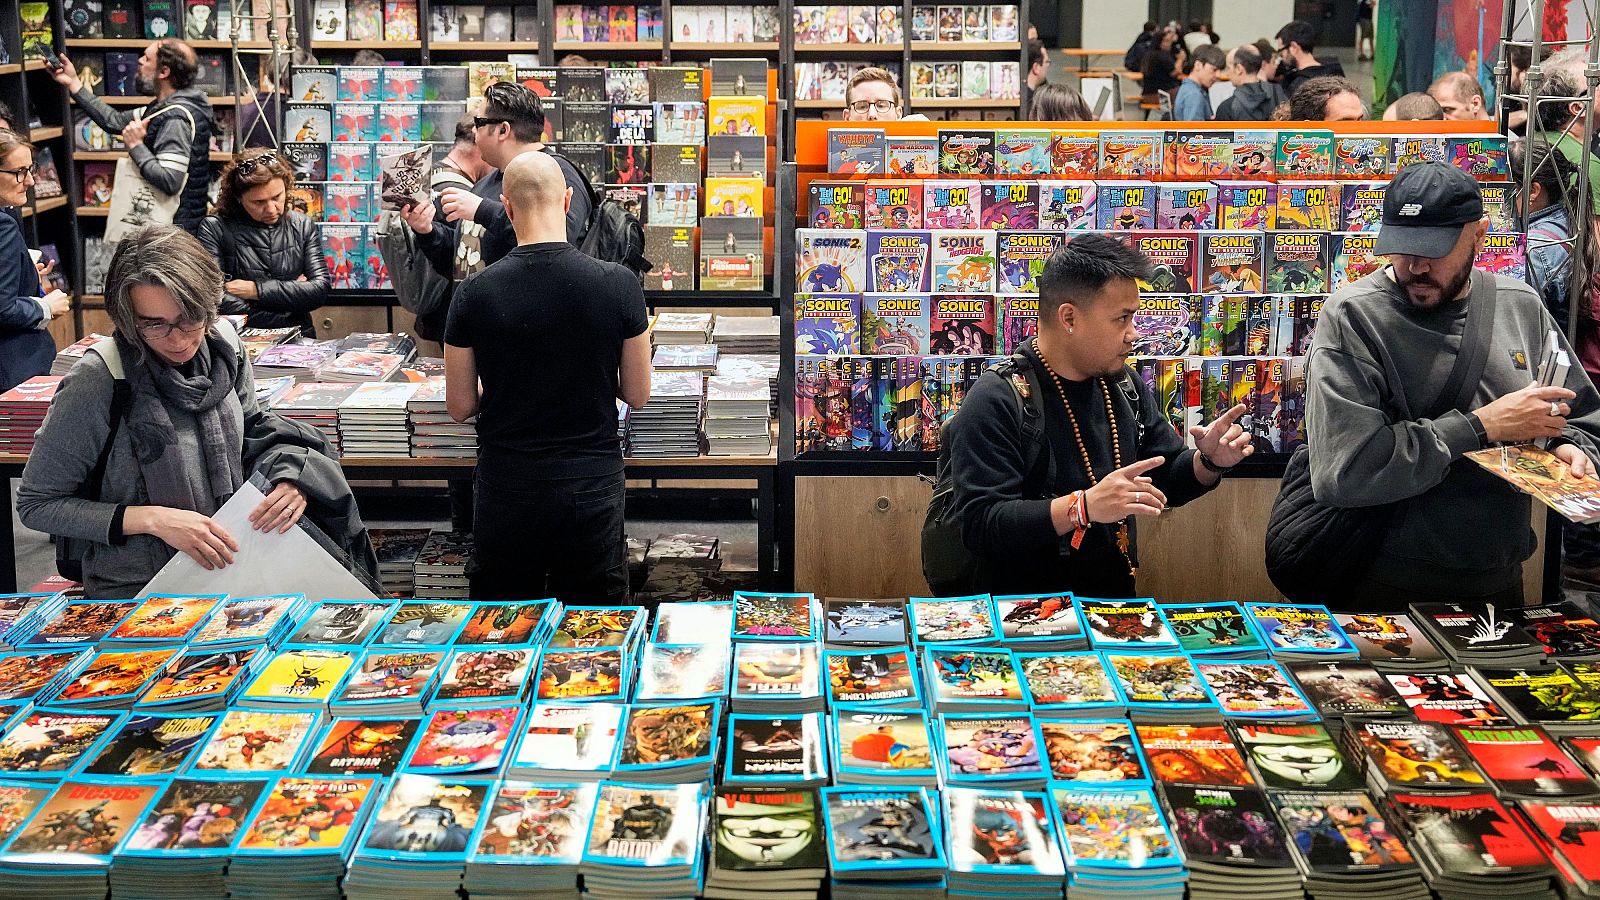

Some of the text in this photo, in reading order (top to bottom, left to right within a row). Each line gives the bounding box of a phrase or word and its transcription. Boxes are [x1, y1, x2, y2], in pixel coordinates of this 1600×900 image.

[1407, 140, 1421, 155] GO!
[1468, 141, 1482, 155] GO!
[834, 187, 853, 204] GO!
[890, 188, 909, 205] GO!
[950, 188, 969, 206] GO!
[1009, 185, 1028, 203] GO!
[1065, 188, 1082, 204] GO!
[1125, 188, 1145, 206] GO!
[1187, 189, 1208, 207] GO!
[1247, 188, 1267, 206] GO!
[1305, 188, 1326, 206] GO!
[1481, 190, 1504, 198] ONIC
[813, 238, 850, 247] SONIC
[880, 237, 920, 248] SONIC
[940, 236, 984, 248] SONIC
[1009, 236, 1052, 246] SONIC
[1141, 239, 1187, 250] SONIC
[1210, 236, 1253, 247] SONIC
[1276, 235, 1319, 246] SONIC
[1345, 238, 1378, 249] SONI
[1484, 236, 1515, 247] ONIC
[954, 246, 985, 257] HEDGEHOG
[806, 300, 851, 311] SONIC
[878, 300, 920, 310] SONIC
[939, 301, 984, 312] SONIC
[1011, 300, 1039, 310] SON
[1140, 300, 1181, 310] SONIC
[347, 685, 412, 699] SUPERMAN
[839, 689, 909, 700] KINGDOM COME
[38, 716, 111, 728] SUPERMAN
[1243, 726, 1257, 737] V
[1271, 727, 1320, 735] VENDETTA
[1459, 729, 1542, 742] BATMAN
[330, 758, 382, 767] BATMAN
[724, 793, 738, 809] V
[755, 795, 805, 805] VENDETTA
